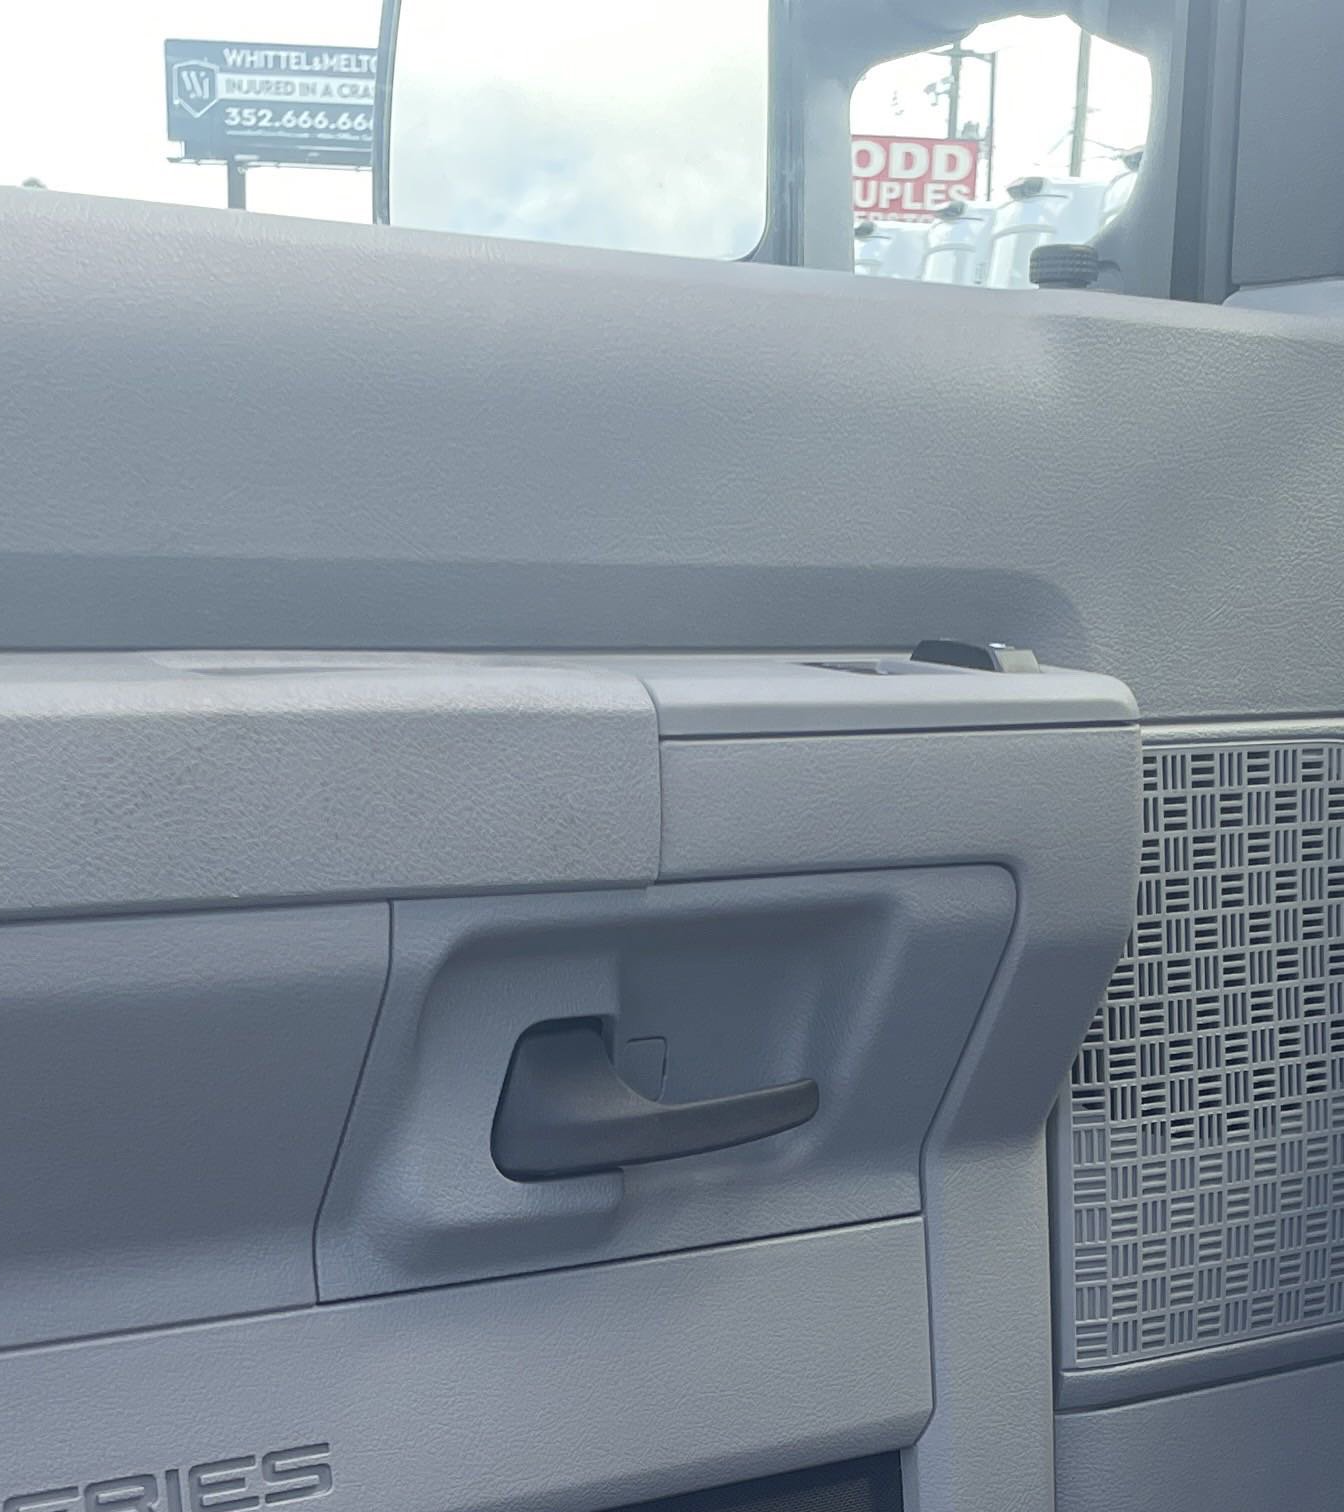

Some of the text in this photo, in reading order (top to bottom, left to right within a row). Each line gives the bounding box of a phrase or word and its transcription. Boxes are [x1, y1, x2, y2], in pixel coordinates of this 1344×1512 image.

[298, 80, 318, 97] IN
[319, 82, 334, 99] A
[337, 83, 375, 98] CRA
